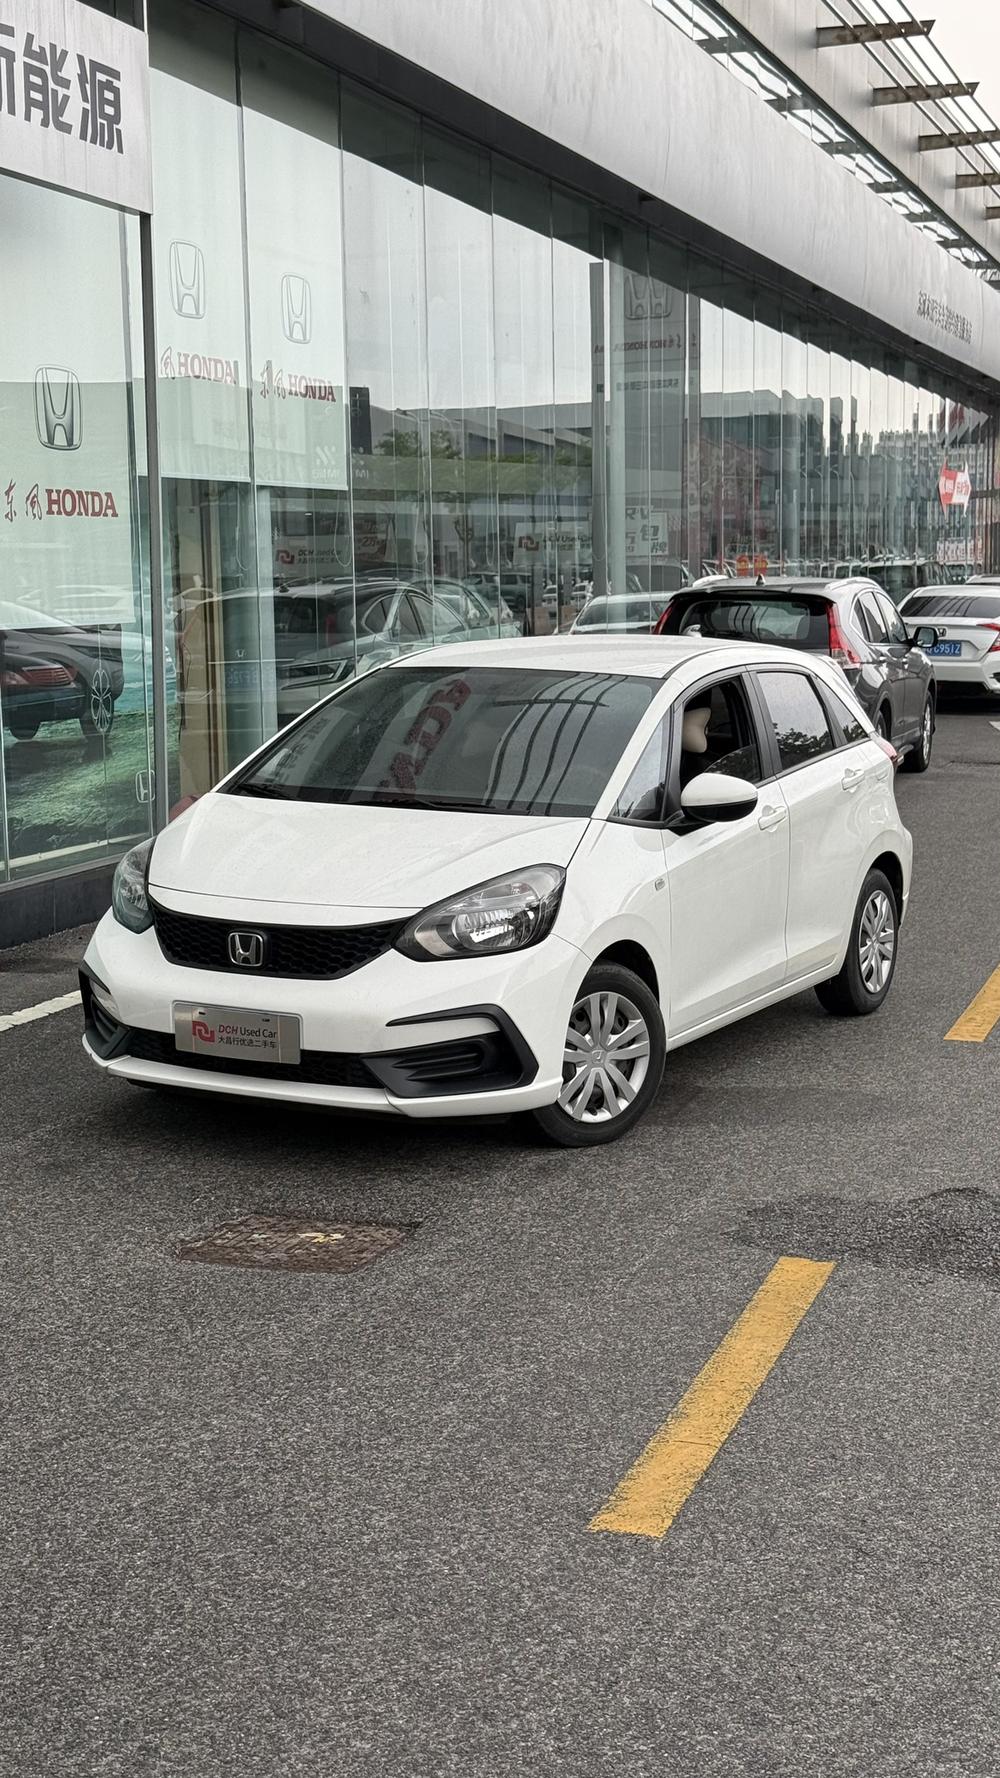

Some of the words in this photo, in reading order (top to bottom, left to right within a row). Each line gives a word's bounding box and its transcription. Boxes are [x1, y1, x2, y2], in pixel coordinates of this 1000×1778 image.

[177, 351, 237, 385] HONDA
[288, 374, 336, 402] HONDA
[45, 488, 119, 518] HONDA
[218, 1024, 238, 1034] DCH
[239, 1026, 260, 1037] Used
[262, 1029, 277, 1039] Car
